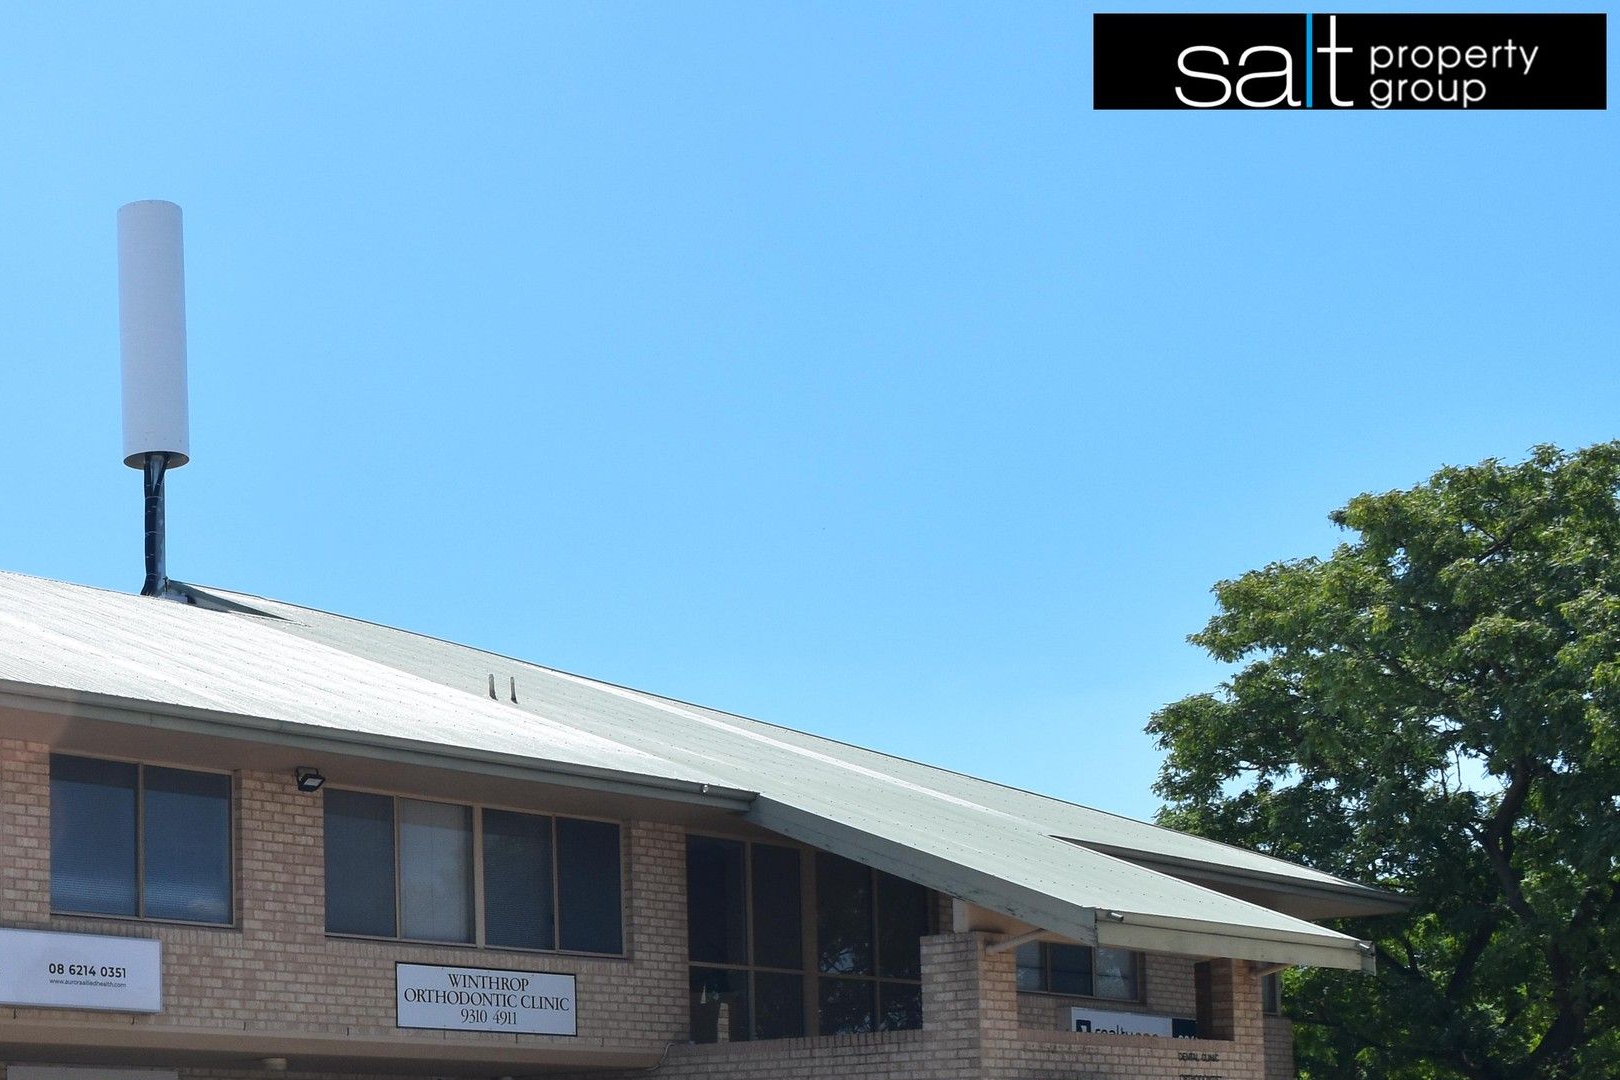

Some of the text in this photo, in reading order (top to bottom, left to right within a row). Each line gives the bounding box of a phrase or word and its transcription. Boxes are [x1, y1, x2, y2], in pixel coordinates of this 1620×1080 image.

[48, 962, 127, 979] 08 6214 0351
[448, 973, 530, 992] WINTHROP
[404, 987, 570, 1011] ORTHODONTIC CLINIC
[460, 1008, 517, 1025] 9310 4911
